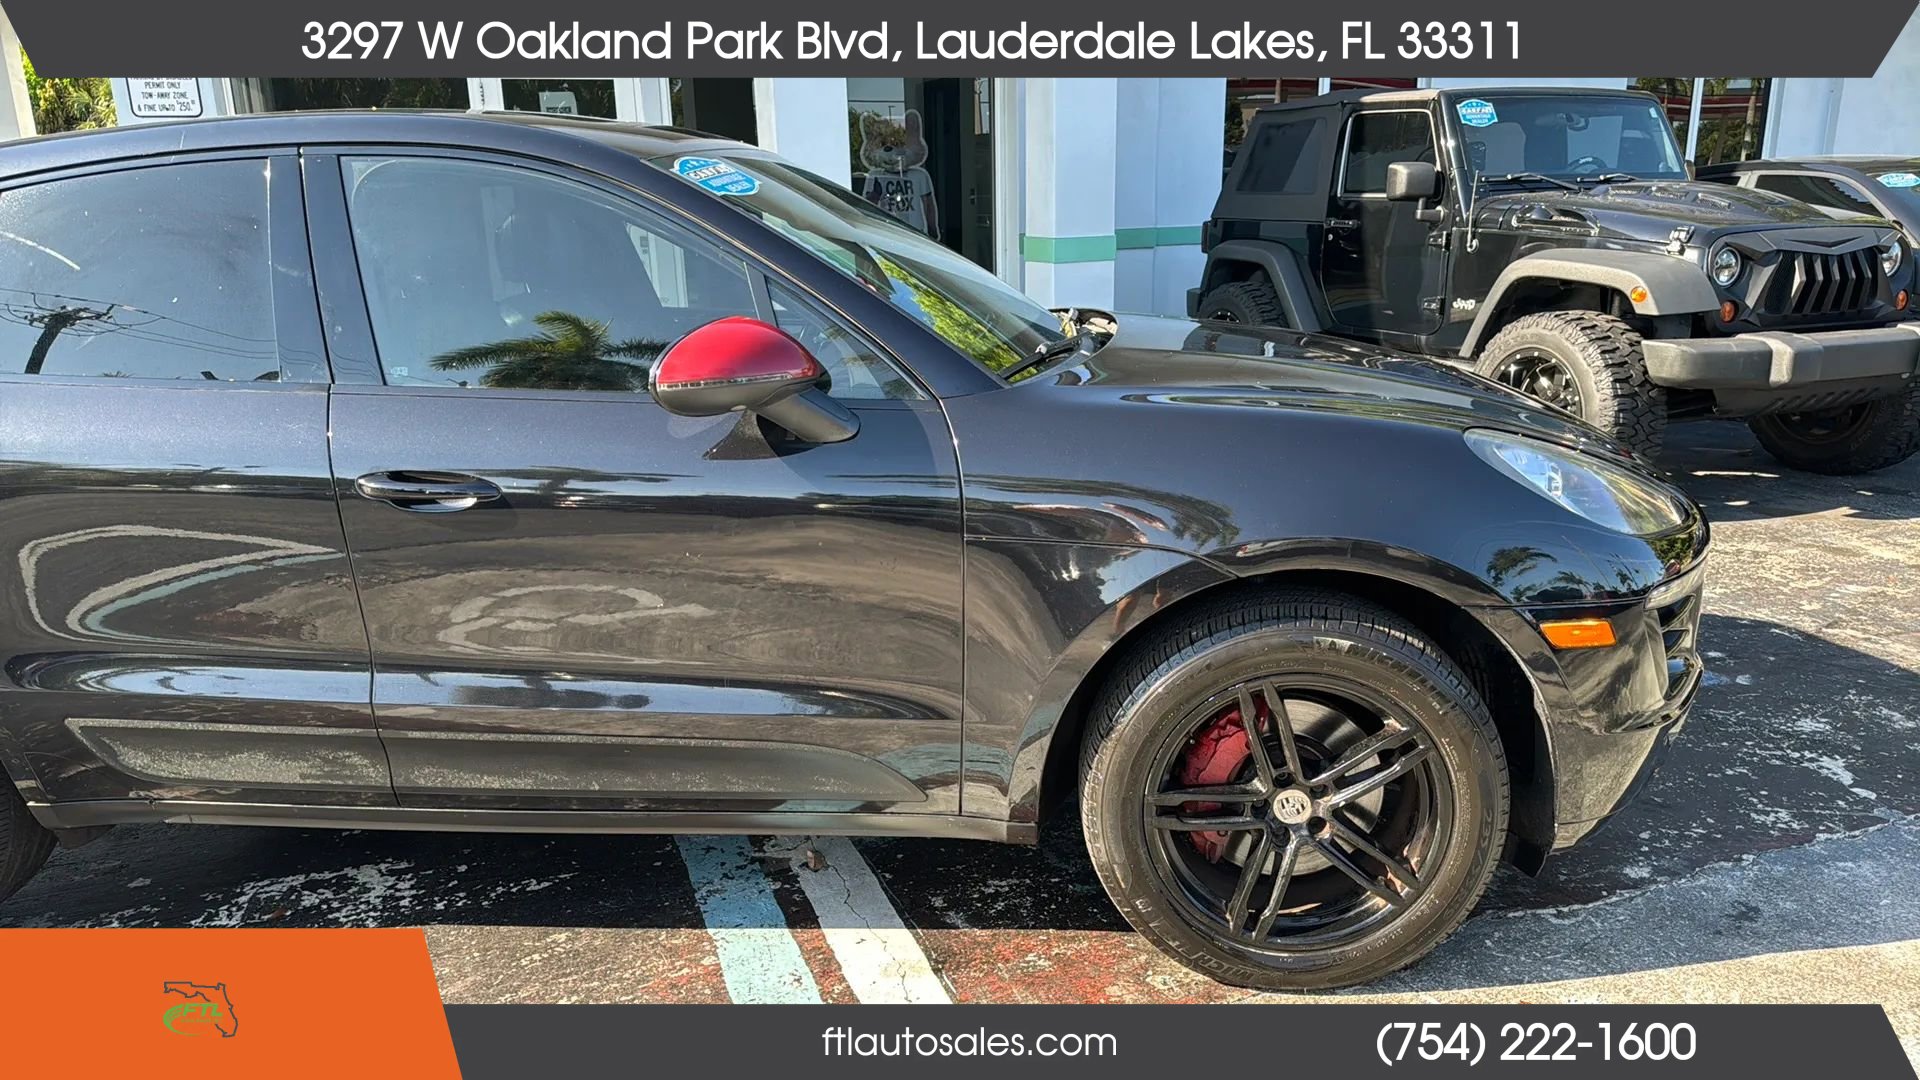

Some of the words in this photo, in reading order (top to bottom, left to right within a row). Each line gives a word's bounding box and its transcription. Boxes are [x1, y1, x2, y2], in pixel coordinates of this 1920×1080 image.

[144, 81, 165, 89] PERMIT
[167, 81, 181, 89] ONLY
[173, 91, 189, 99] ZONE
[886, 180, 914, 195] CAR
[888, 197, 915, 212] FOX
